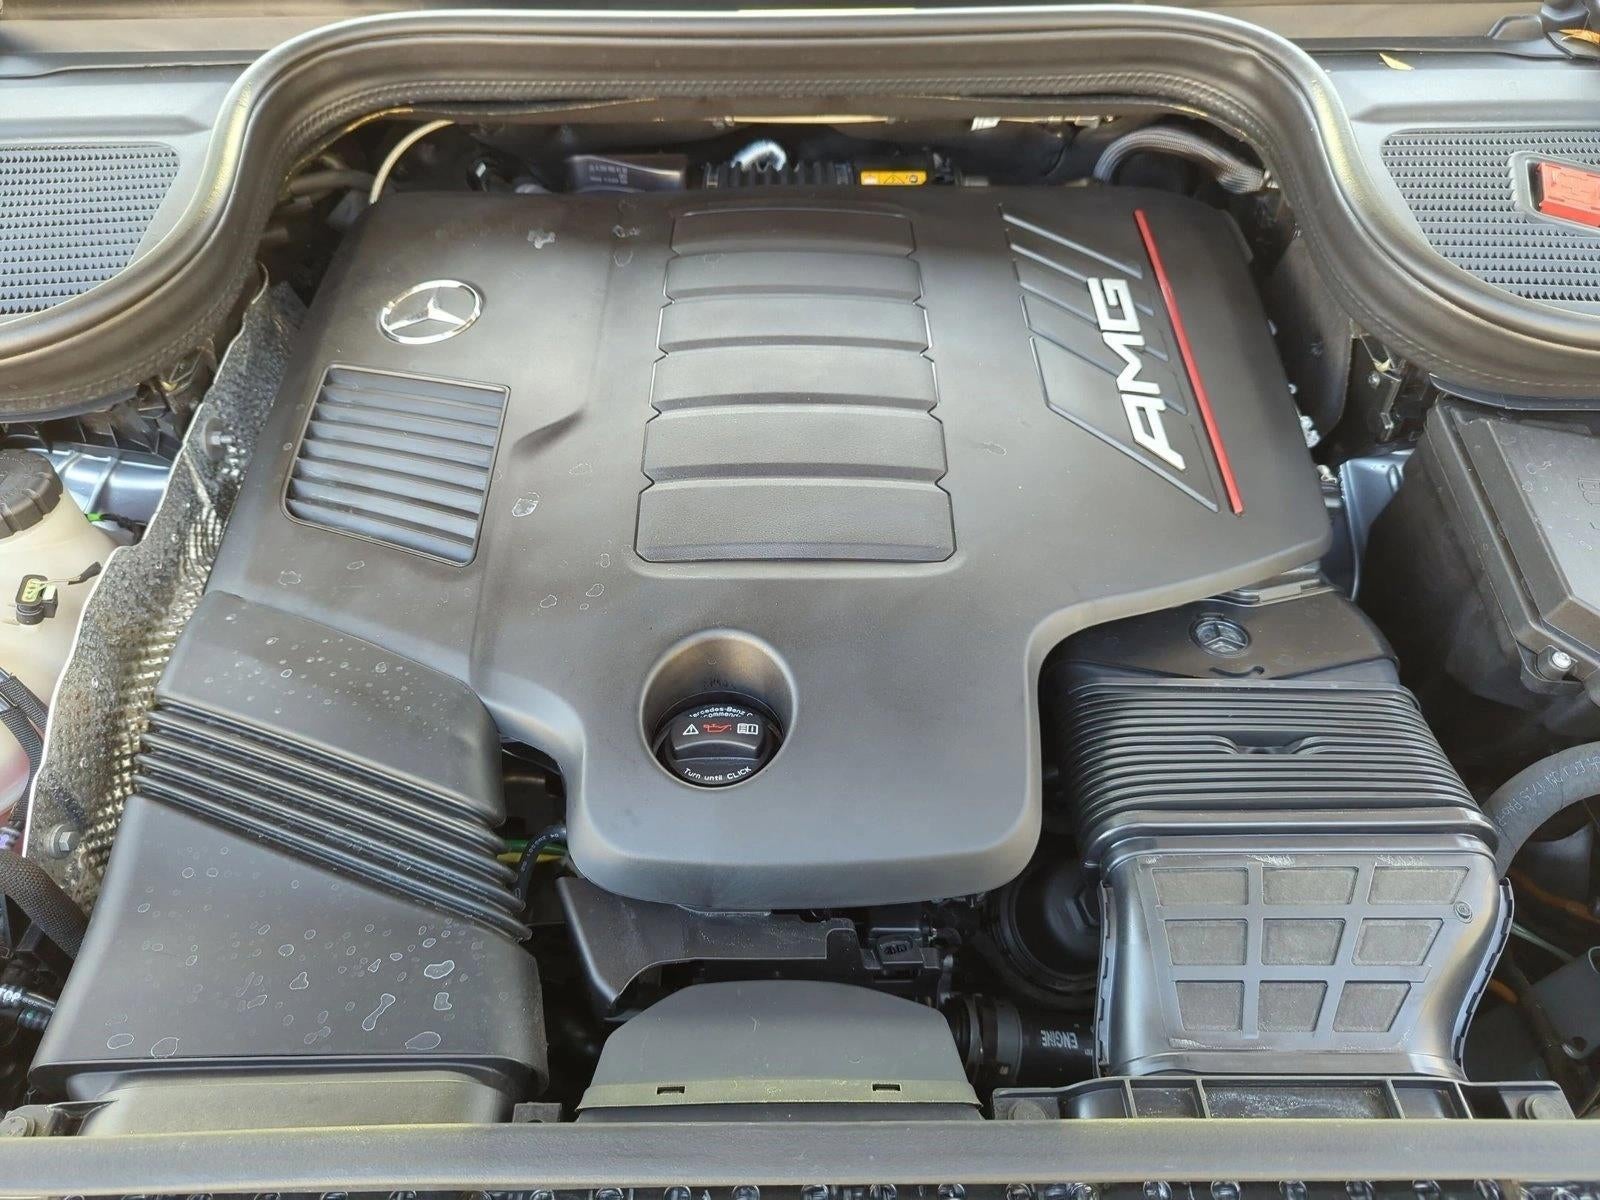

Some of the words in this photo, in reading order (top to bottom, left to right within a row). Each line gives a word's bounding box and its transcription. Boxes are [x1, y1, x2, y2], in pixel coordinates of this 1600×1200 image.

[1087, 277, 1186, 471] AMG
[689, 706, 746, 718] ercedes-Benz
[684, 767, 701, 780] Turn
[726, 766, 752, 780] CLICK
[1040, 1030, 1079, 1050] ENGINE
